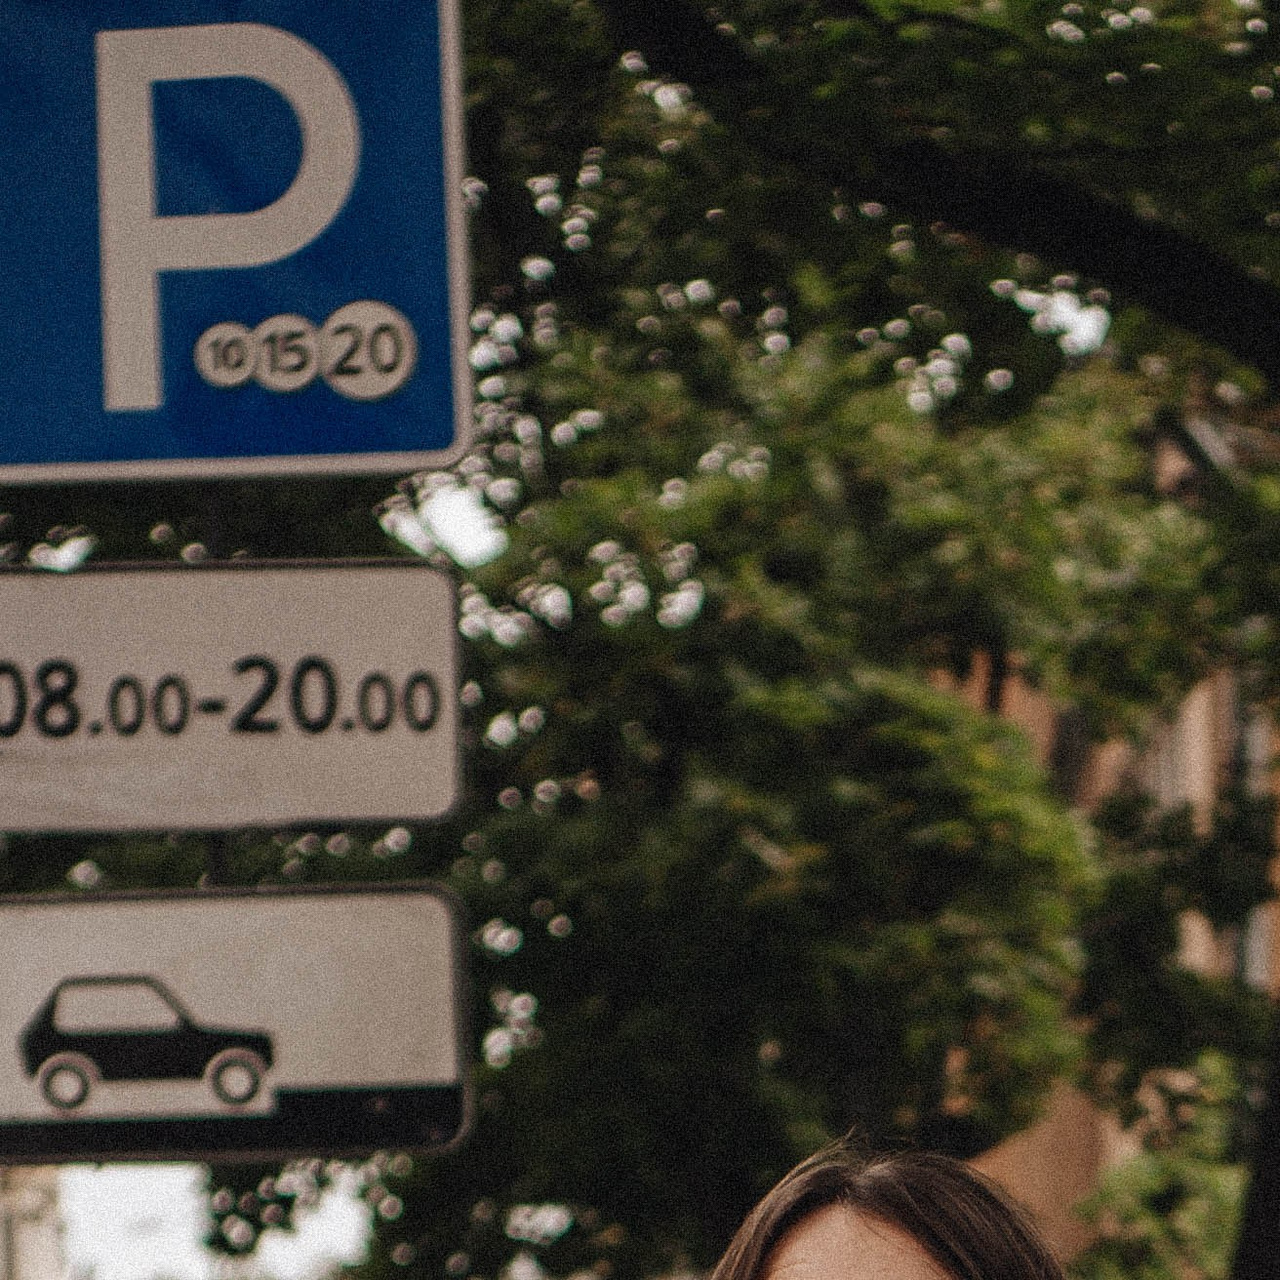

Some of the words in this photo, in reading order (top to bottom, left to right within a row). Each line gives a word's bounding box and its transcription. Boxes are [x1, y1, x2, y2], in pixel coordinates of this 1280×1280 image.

[96, 22, 361, 411] P
[210, 337, 245, 370] 10
[265, 332, 311, 373] 15
[333, 323, 402, 375] 20
